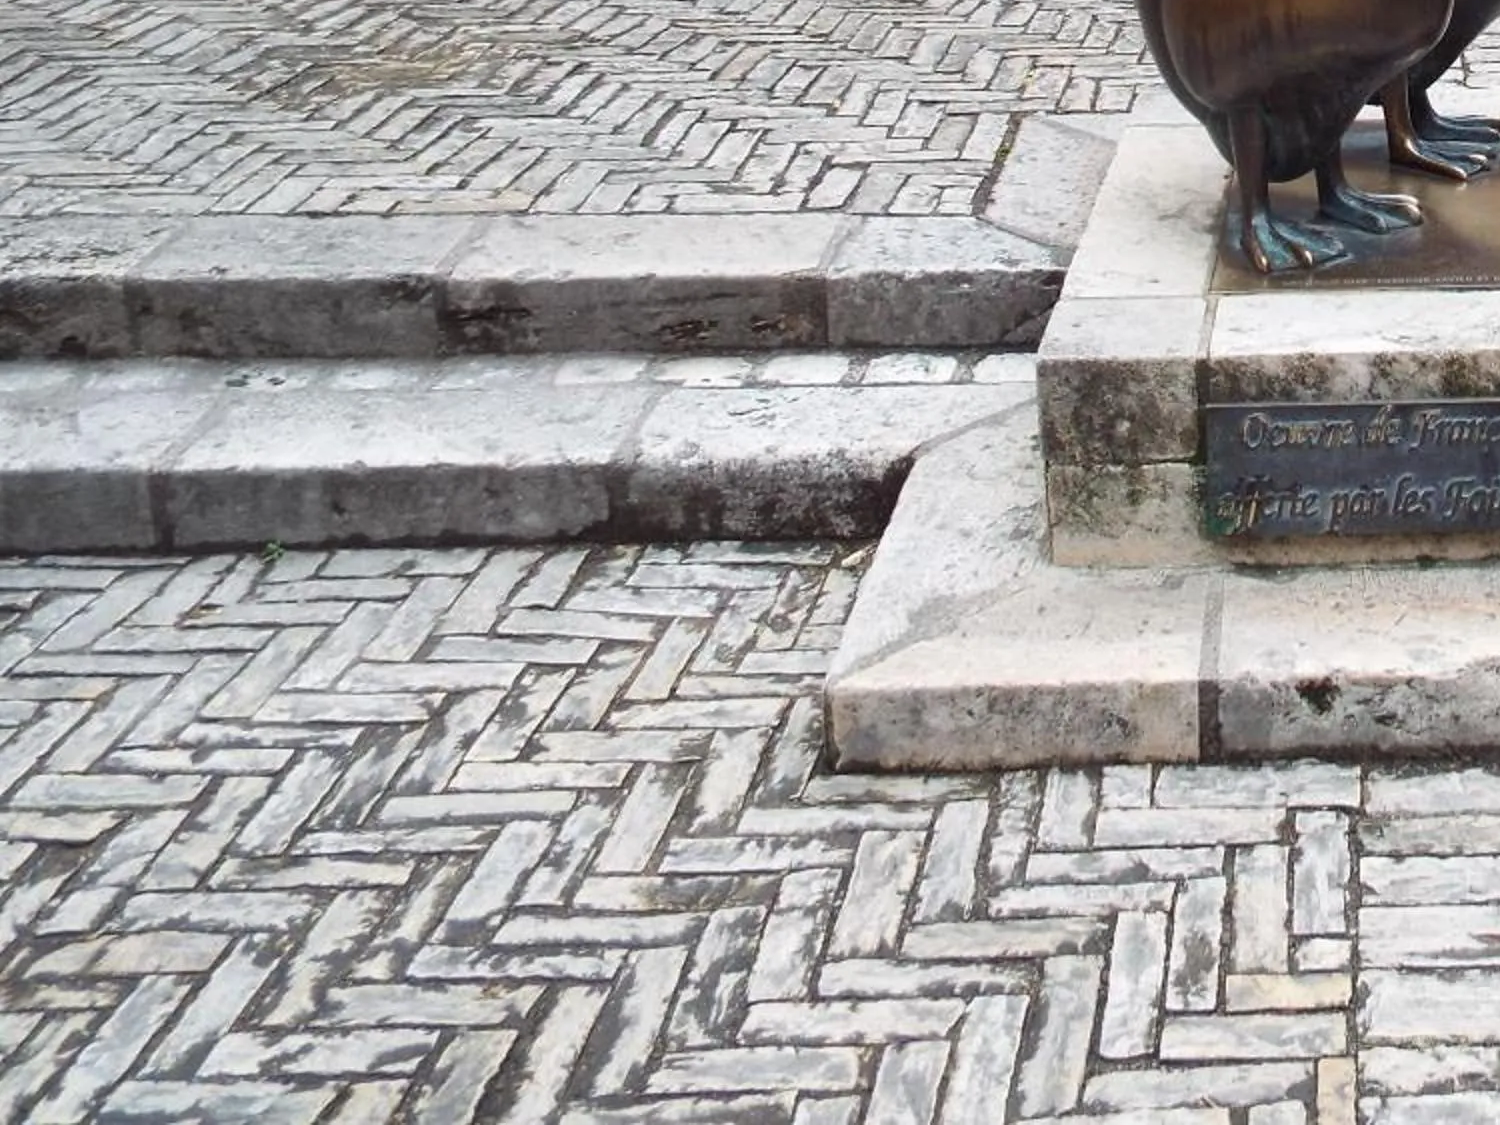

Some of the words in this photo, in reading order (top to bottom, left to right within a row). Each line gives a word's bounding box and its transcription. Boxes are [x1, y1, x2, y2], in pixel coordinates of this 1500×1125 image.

[1361, 404, 1402, 445] de
[1322, 486, 1386, 536] par
[1391, 472, 1438, 515] les
